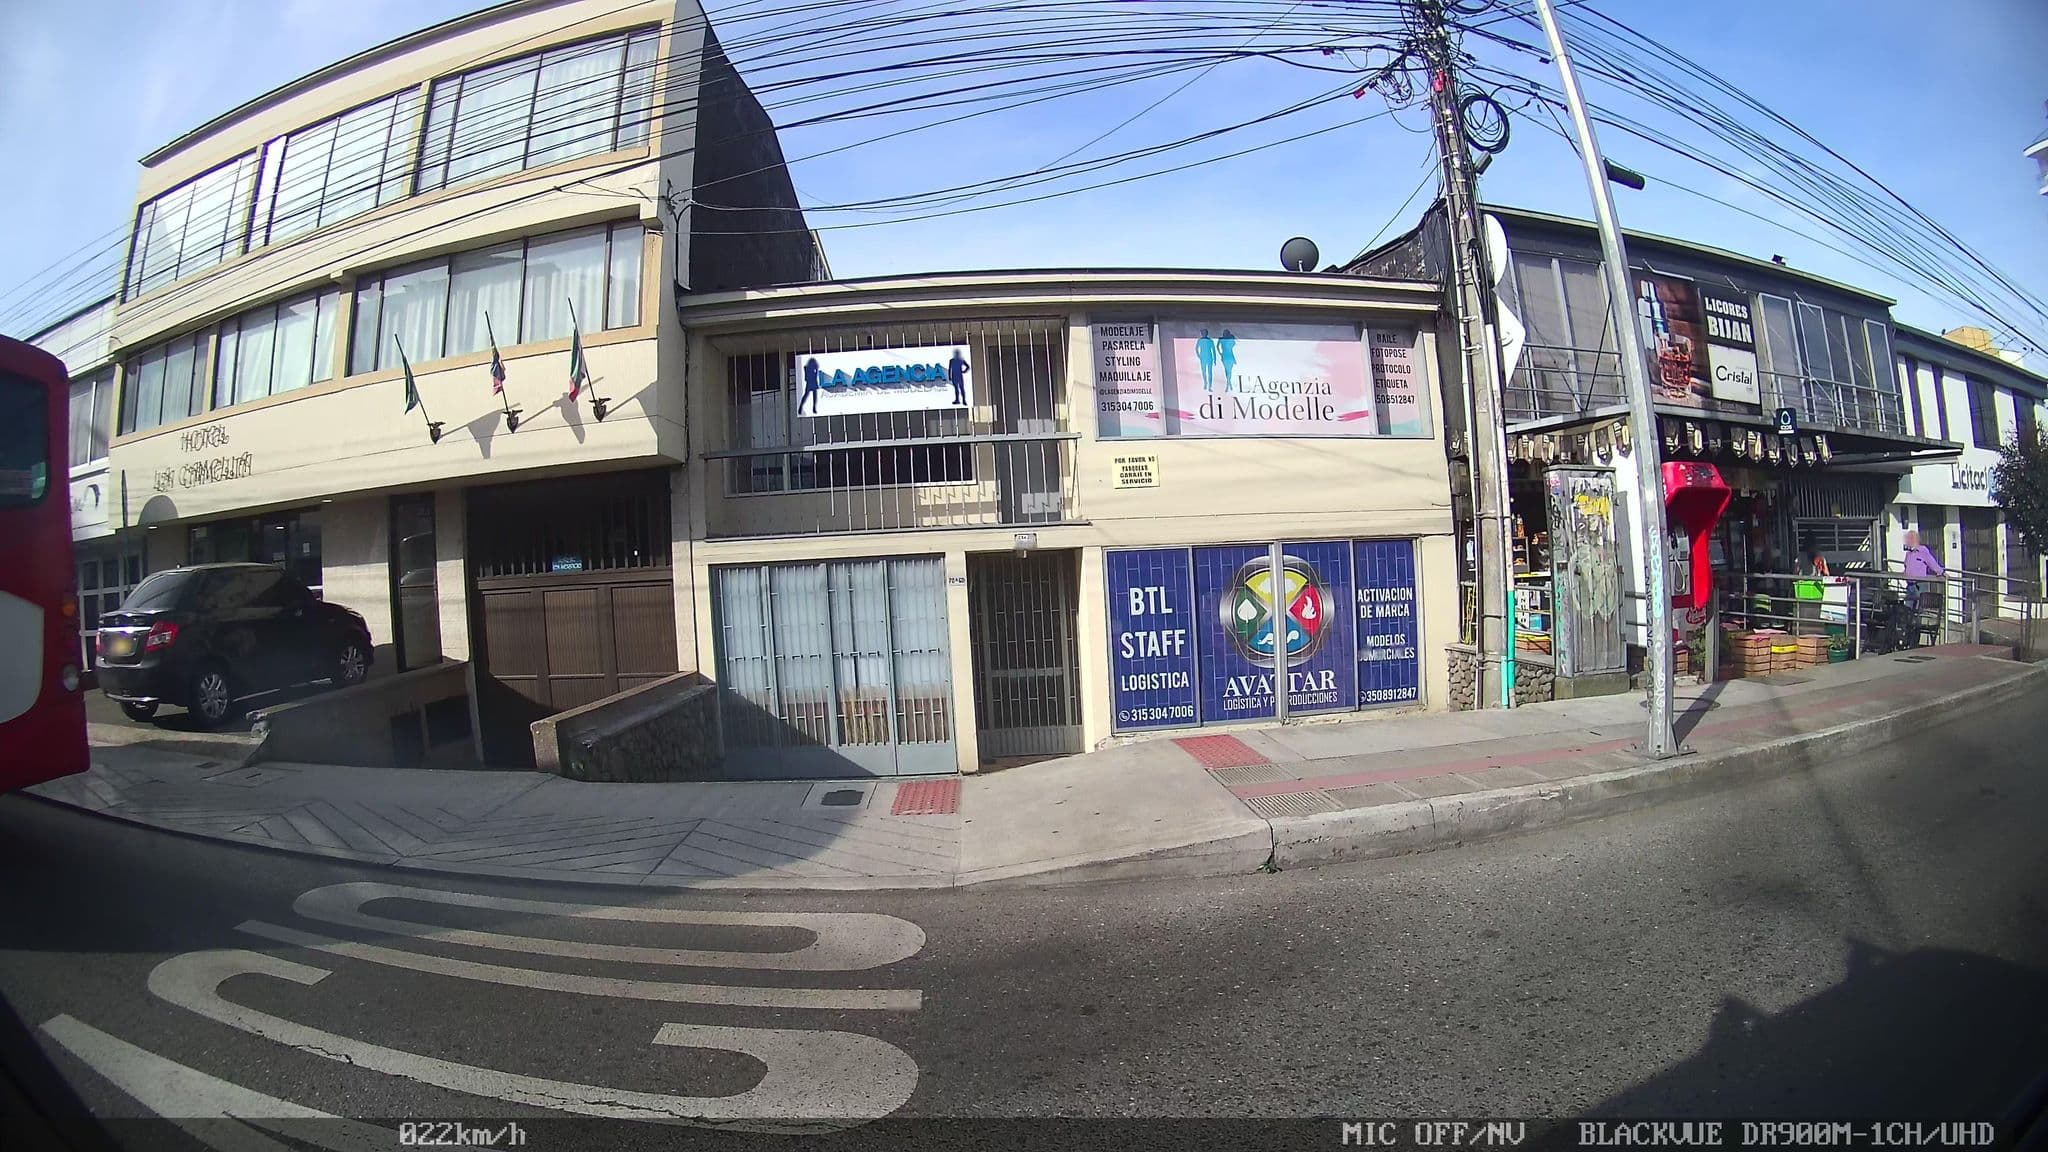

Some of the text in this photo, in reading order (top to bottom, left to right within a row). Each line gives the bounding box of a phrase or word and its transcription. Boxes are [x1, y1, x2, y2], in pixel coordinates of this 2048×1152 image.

[1704, 296, 1748, 319] LICORES
[1100, 326, 1145, 337] MODELAJE
[1102, 341, 1146, 351] PASARELA
[1105, 356, 1141, 367] STYLING
[818, 362, 948, 389] LA AGENCIA
[1099, 371, 1152, 382] MAQUILLAJE
[1715, 365, 1753, 386] Cristal
[1375, 379, 1408, 390] ETIQUETA
[1101, 401, 1154, 412] 3153047006
[1199, 394, 1335, 421] di Modelle
[1129, 586, 1173, 616] BTL
[1357, 587, 1413, 603] ACTIVACION
[1360, 603, 1410, 619] DE MARCA
[1120, 629, 1186, 659] STAFF
[1366, 633, 1406, 647] MODELOS
[1121, 671, 1189, 692] LOGISTICA
[1263, 696, 1270, 708] Y
[1366, 687, 1417, 702] 3508912847
[1131, 705, 1194, 721] 3153047006
